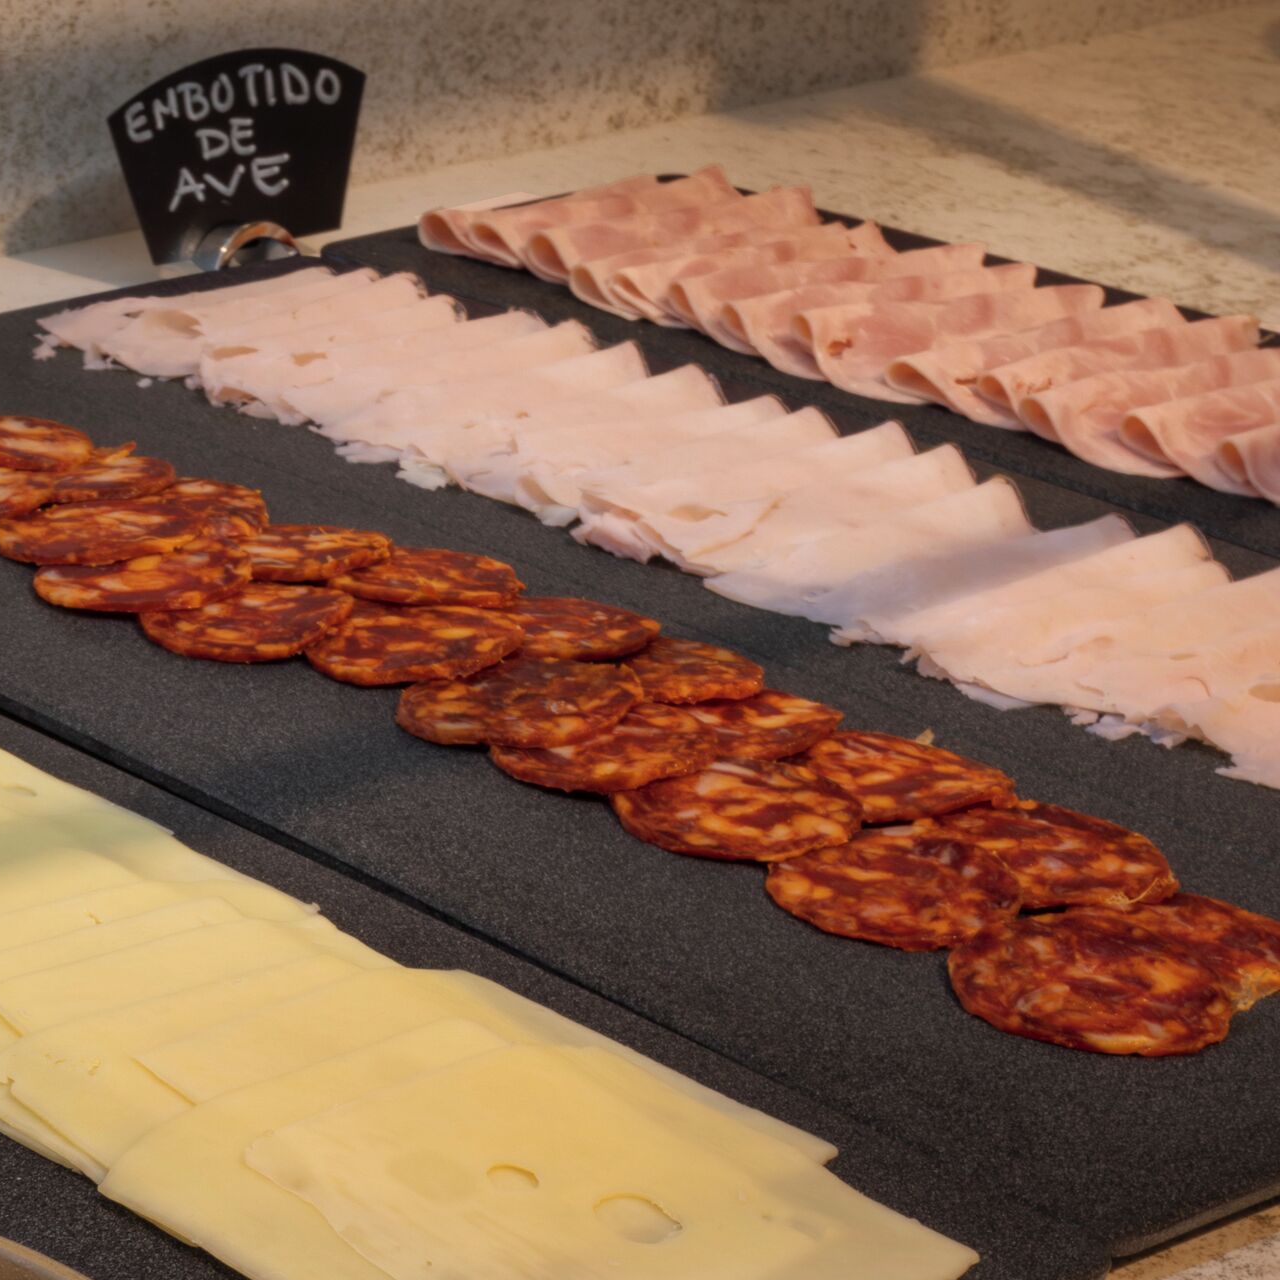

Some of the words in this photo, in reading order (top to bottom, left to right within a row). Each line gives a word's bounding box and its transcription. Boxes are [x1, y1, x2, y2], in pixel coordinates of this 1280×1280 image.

[124, 63, 340, 143] EMBOTIDO
[195, 117, 256, 161] DE
[169, 153, 290, 212] AVE
